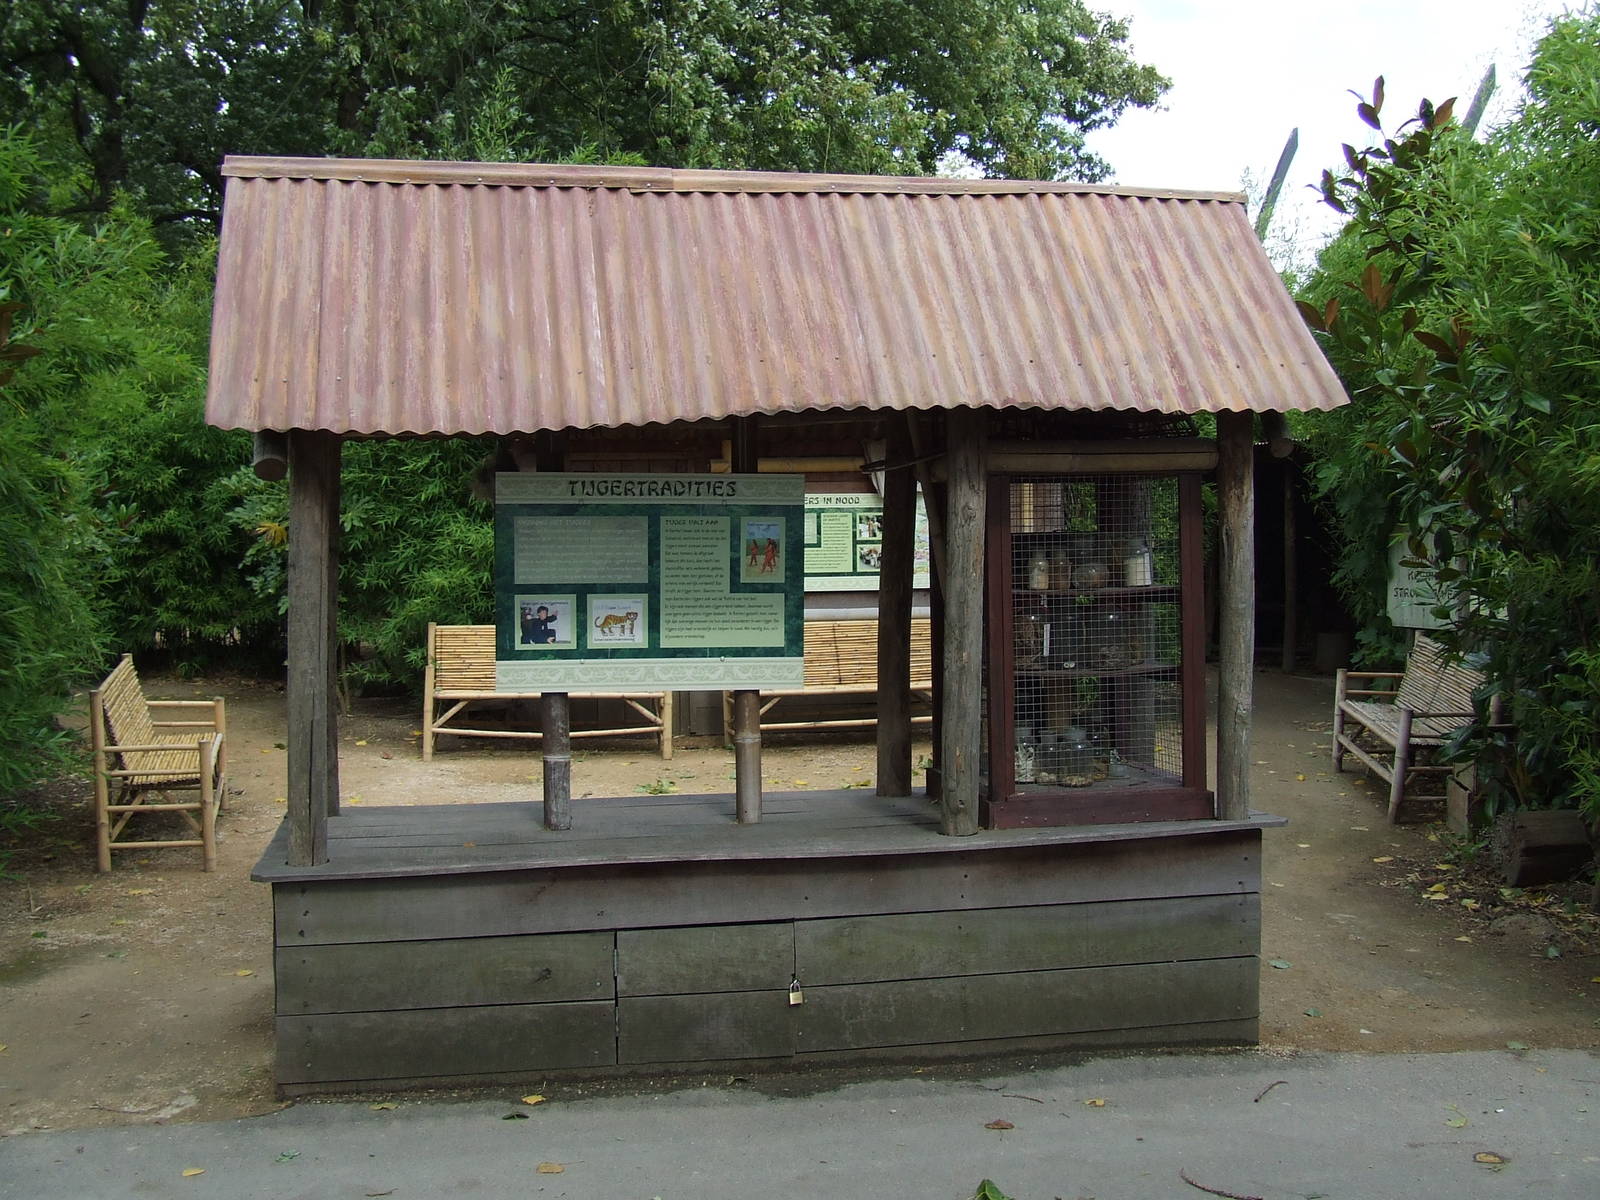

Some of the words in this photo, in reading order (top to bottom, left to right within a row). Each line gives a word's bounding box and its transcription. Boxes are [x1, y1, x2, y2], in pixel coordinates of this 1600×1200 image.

[568, 479, 736, 497] TIJGERTRADITIES
[823, 496, 832, 505] IN
[835, 496, 860, 505] NOOD
